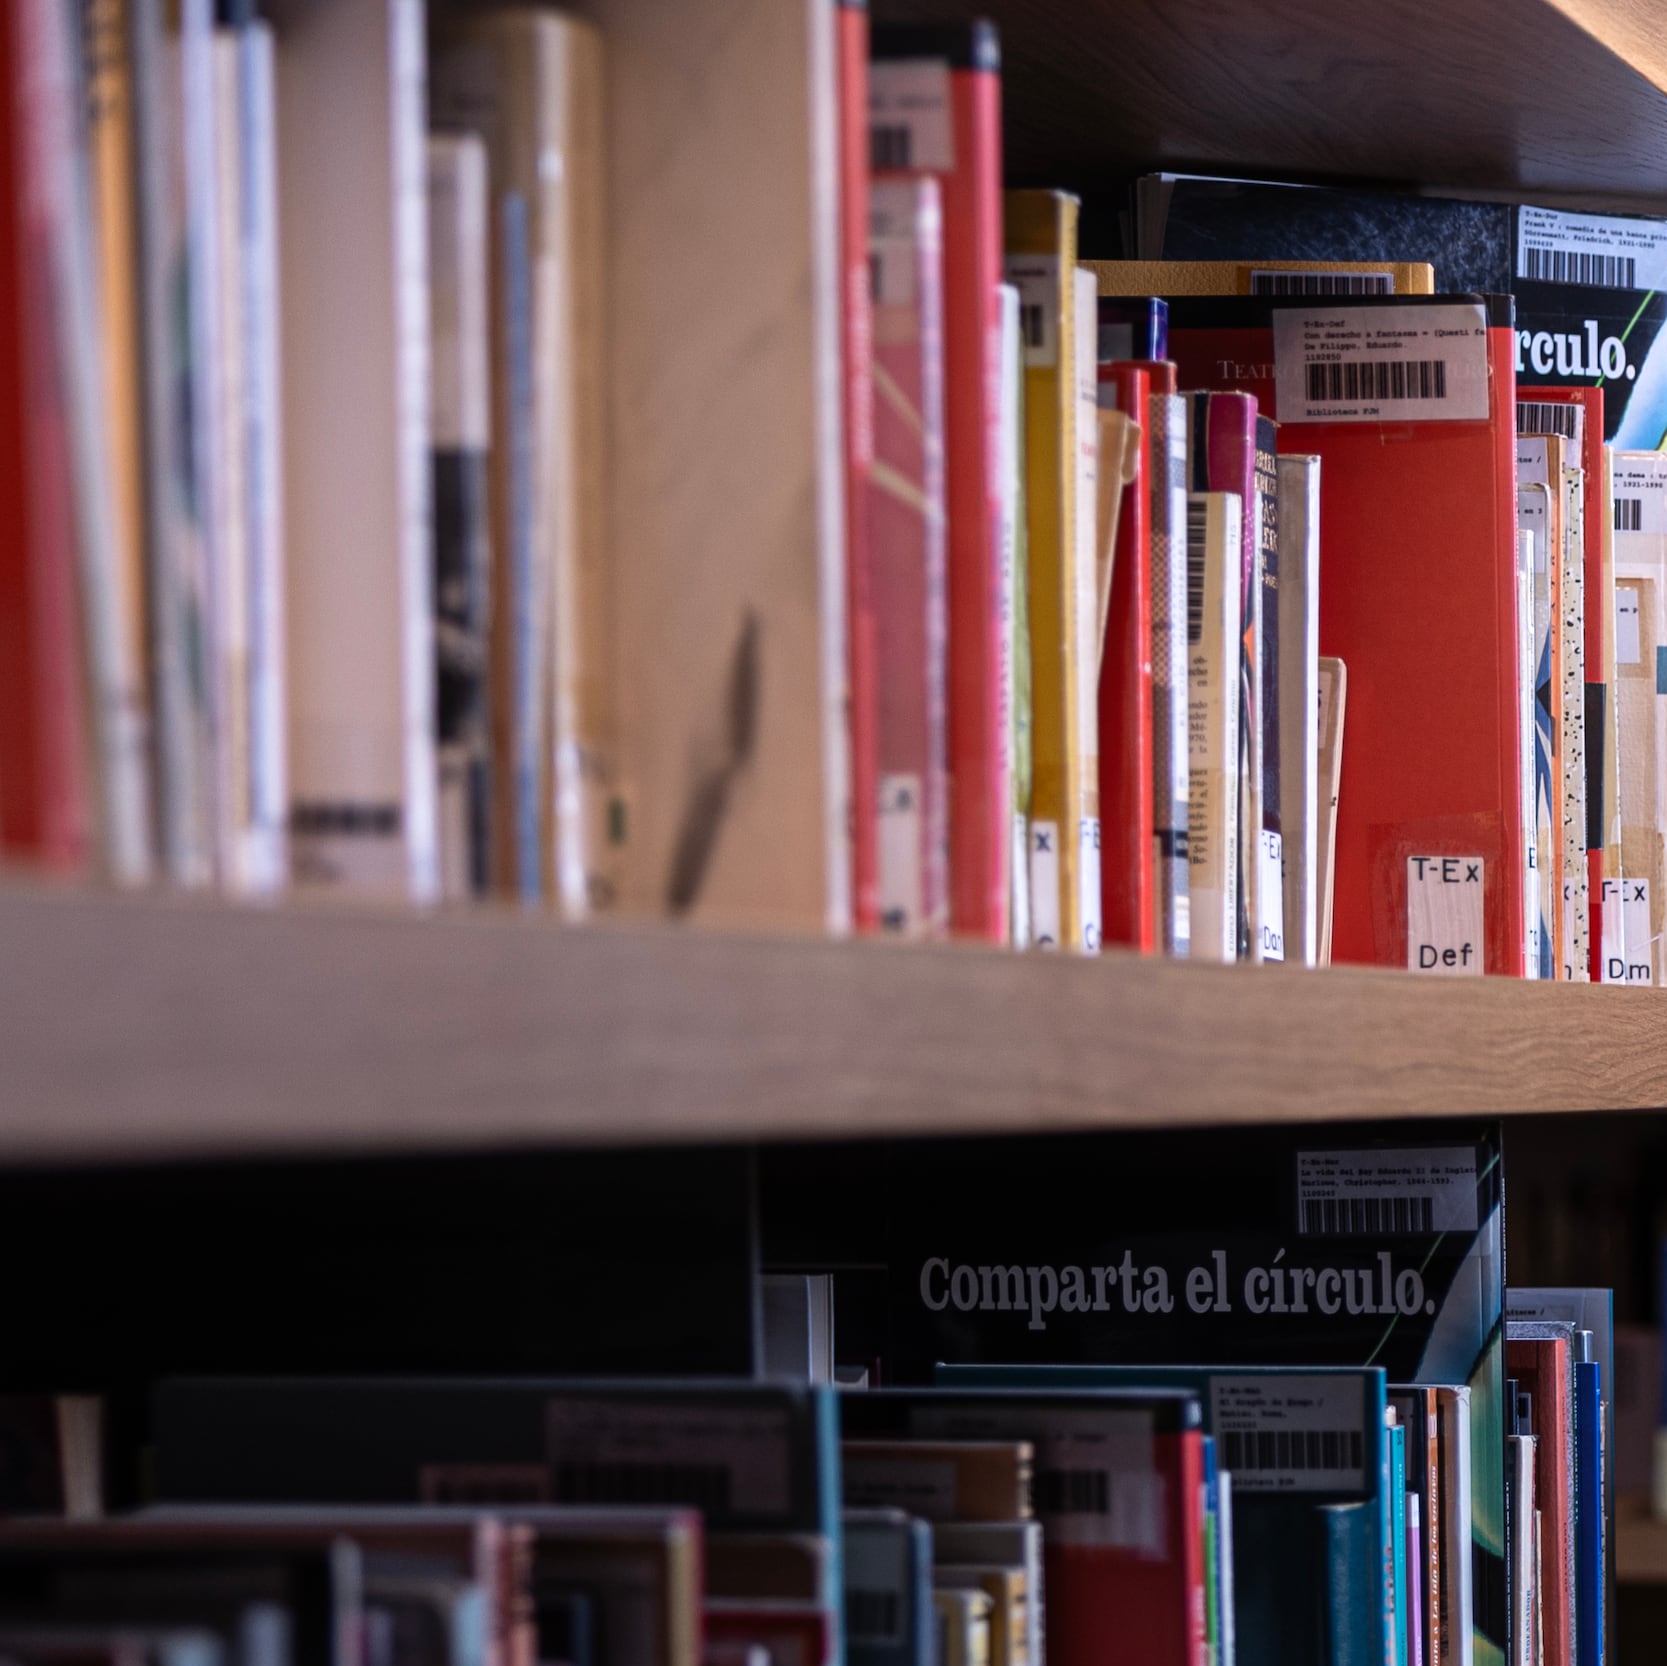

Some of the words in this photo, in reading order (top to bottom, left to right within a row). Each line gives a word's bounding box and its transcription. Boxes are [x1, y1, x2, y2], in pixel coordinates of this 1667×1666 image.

[1514, 320, 1636, 381] rculo.
[1419, 939, 1474, 968] Def
[919, 1250, 1174, 1330] Comparta
[1185, 1250, 1232, 1313] el
[1244, 1247, 1436, 1316] círculo.
